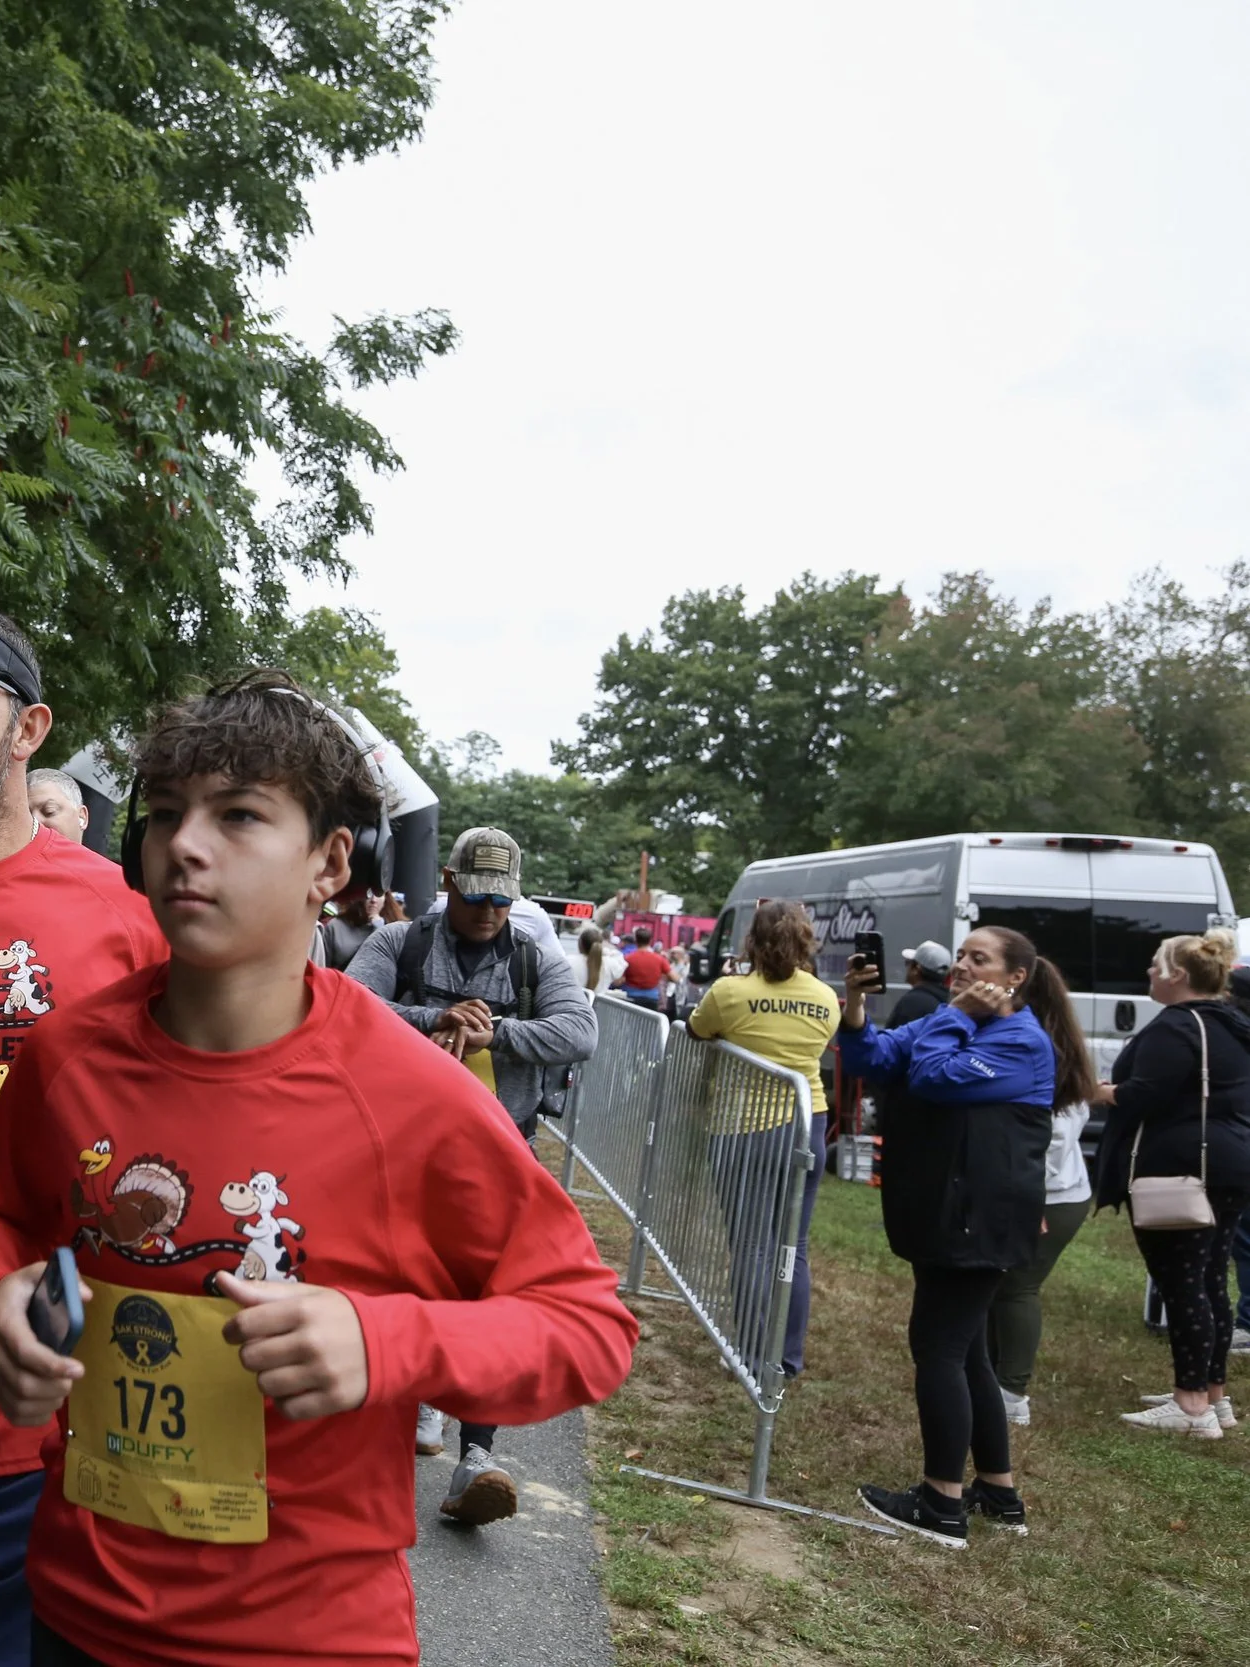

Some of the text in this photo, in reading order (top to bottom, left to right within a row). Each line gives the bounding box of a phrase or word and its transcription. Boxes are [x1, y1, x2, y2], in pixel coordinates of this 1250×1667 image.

[748, 999, 830, 1021] VOLUNTEER
[133, 1325, 172, 1344] STRONG
[113, 1375, 186, 1441] 173
[122, 1435, 194, 1462] DUFFY
